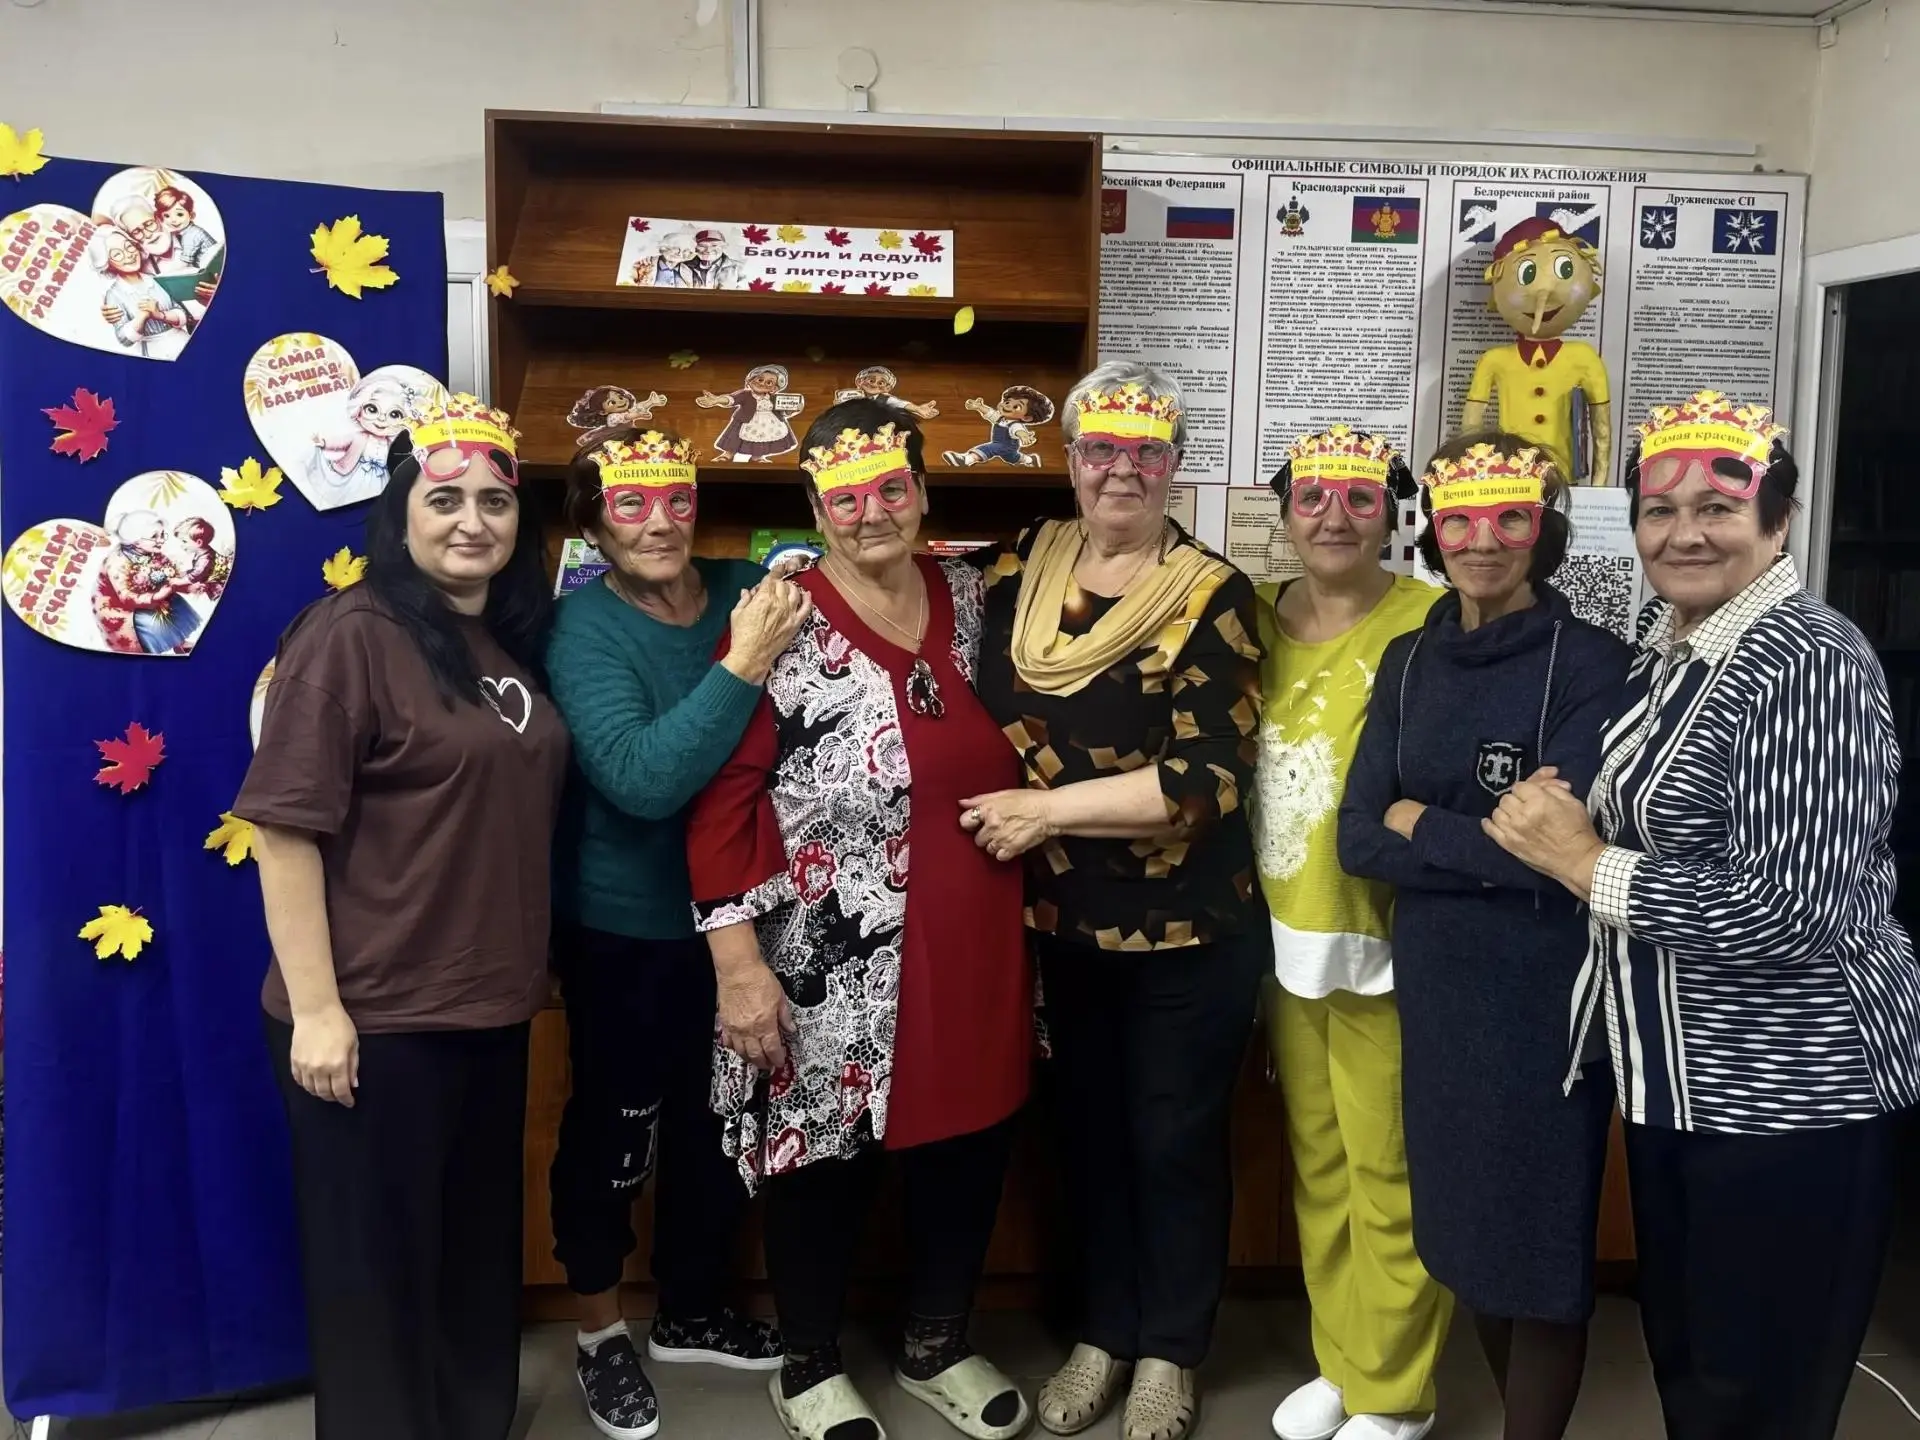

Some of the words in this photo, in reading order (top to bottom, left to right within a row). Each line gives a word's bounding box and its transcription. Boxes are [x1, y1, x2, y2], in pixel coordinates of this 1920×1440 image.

[1232, 159, 1345, 173] ОФИЦИАЛЬНЫЕ
[1350, 162, 1422, 175] СИМВОЛЫ
[1427, 165, 1436, 175] И
[1440, 165, 1506, 178] ПОРЯДОК
[1510, 168, 1530, 178] ИХ
[1533, 168, 1646, 183] РАСПОЛОЖЕНИЯ
[1101, 176, 1162, 187] Российская
[1166, 178, 1226, 190] Федерация
[1292, 181, 1376, 194] Краснодарский
[1379, 184, 1406, 194] край
[1474, 186, 1554, 199] Белореченский
[1558, 189, 1590, 200] район
[1665, 193, 1736, 206] Дружненское
[1738, 196, 1755, 206] СП
[2, 220, 40, 272] ДЕНЬ
[744, 246, 829, 260] Бабули
[859, 252, 942, 263] дедули
[18, 237, 61, 296] ДОБРА
[31, 222, 96, 318] УВАЖЕНИЯ!
[785, 267, 919, 281] литературе
[268, 348, 326, 370] САМАЯ
[268, 362, 338, 389] ЛУЧШАЯ
[263, 378, 349, 408] БАБУШКА!
[1653, 432, 1691, 447] Самая
[1695, 431, 1752, 448] красива
[614, 467, 689, 480] ОБНИМАШКА
[1294, 464, 1333, 472] Отвеаю
[1351, 464, 1386, 476] веселье
[1443, 489, 1474, 500] Вечно
[1480, 486, 1530, 496] заводная
[19, 524, 72, 612] ЖЕЛАЕМ
[578, 568, 606, 576] СТАР
[42, 532, 98, 625] СЧАСТЬЯ!
